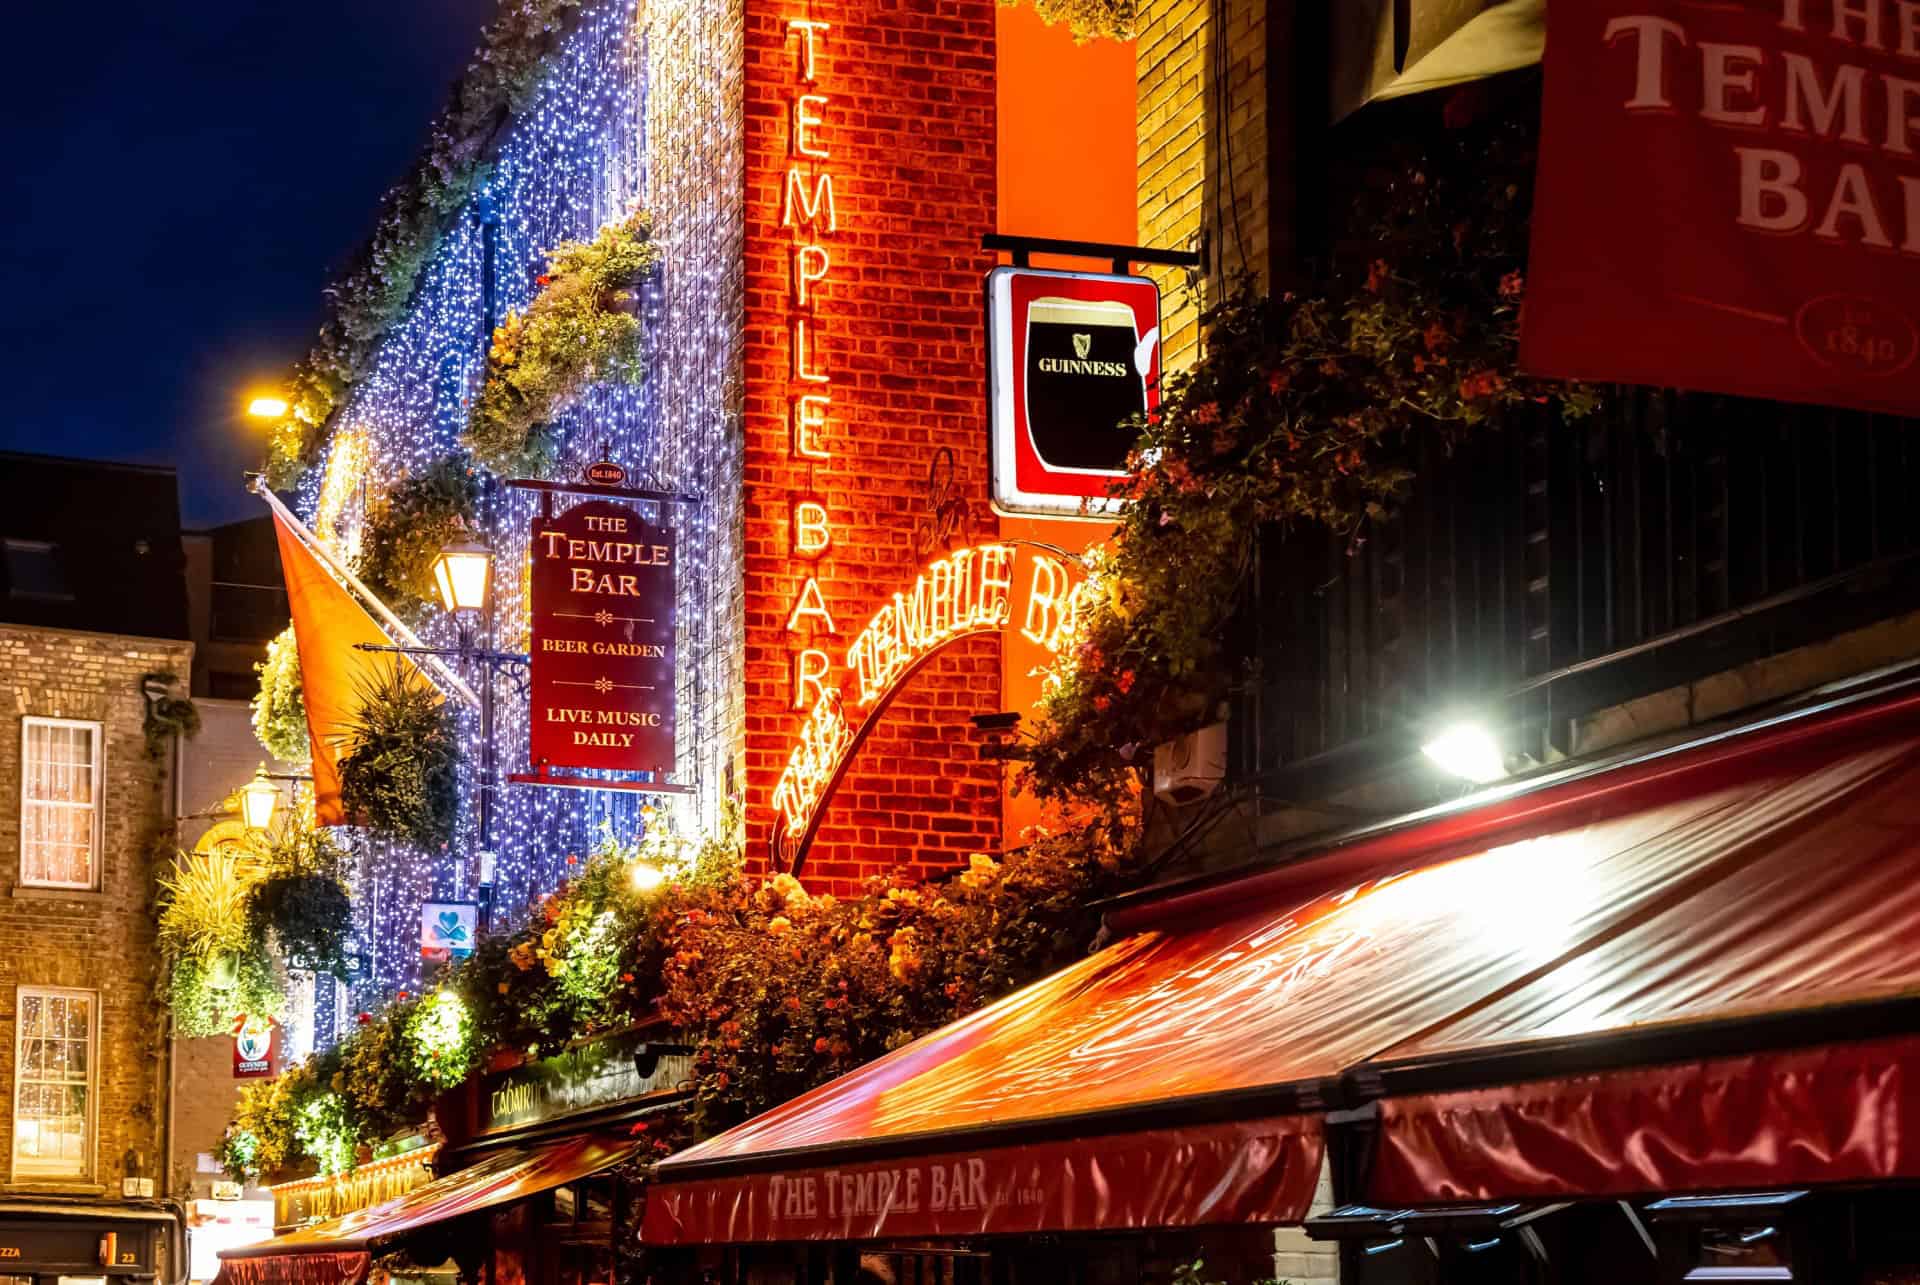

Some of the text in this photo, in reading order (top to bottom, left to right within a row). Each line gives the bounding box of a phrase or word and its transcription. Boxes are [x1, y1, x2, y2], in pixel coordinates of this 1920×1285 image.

[784, 20, 836, 709] TEMPLE BAR
[1038, 357, 1128, 378] GUINNESS
[584, 516, 628, 533] THE
[540, 531, 670, 566] TEMPLE
[570, 567, 641, 597] BAR
[542, 638, 666, 659] BEER GARDEN
[546, 707, 661, 727] LIVE MUSIC
[573, 730, 635, 748] DAILY
[767, 1174, 818, 1220] THE
[823, 1167, 921, 1218] TEMPLE
[929, 1157, 989, 1213] BAR
[121, 1252, 136, 1264] 23
